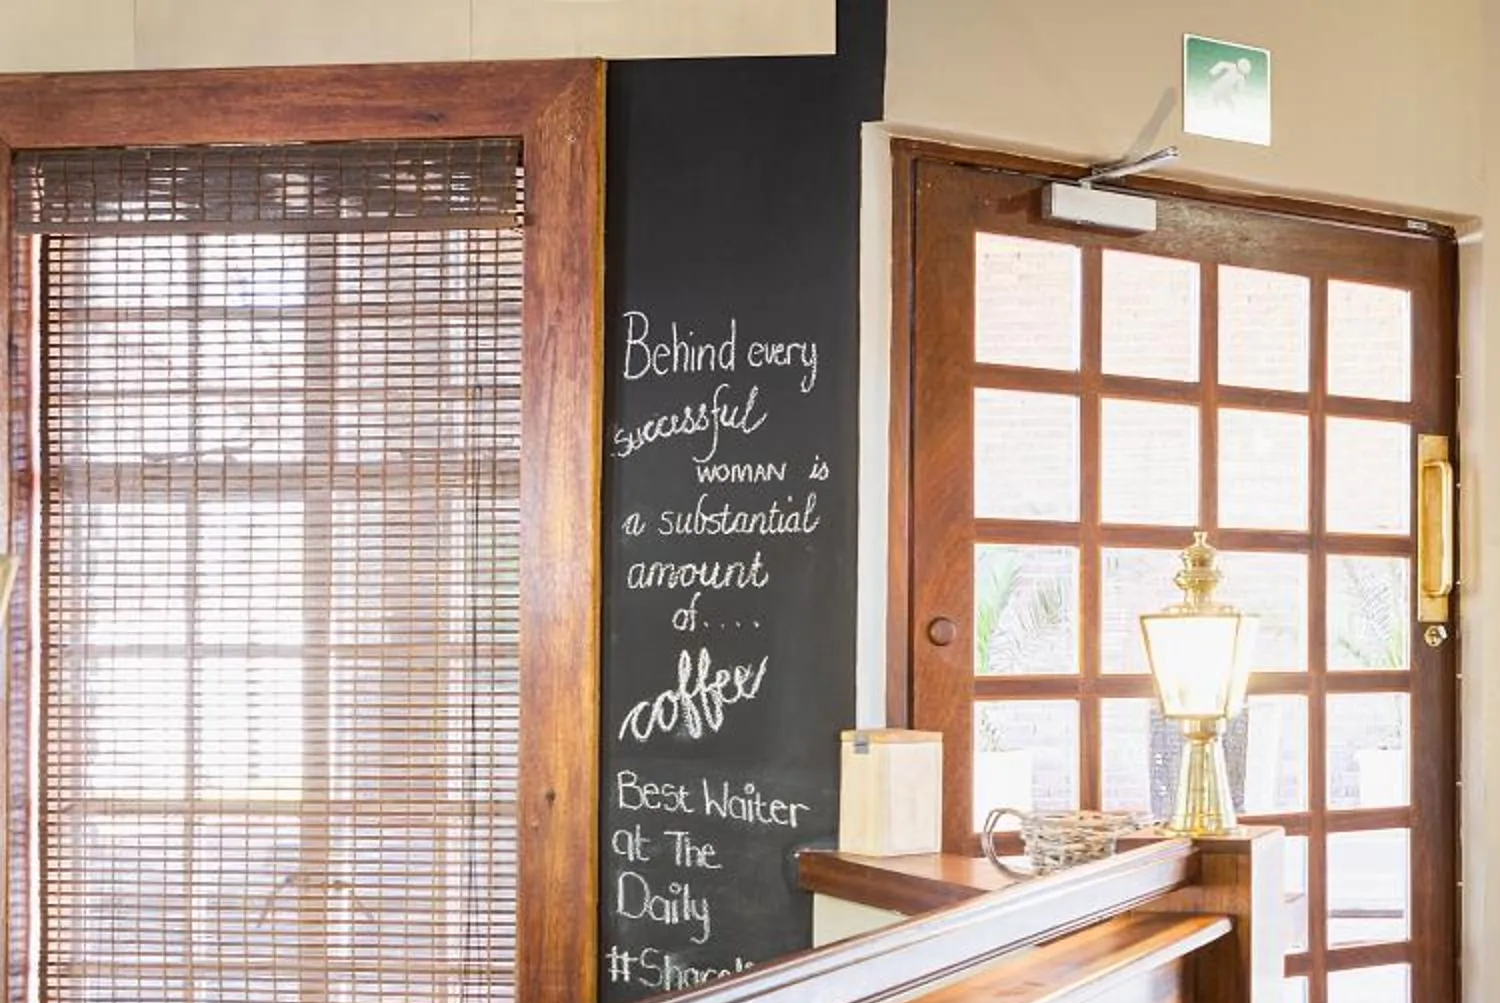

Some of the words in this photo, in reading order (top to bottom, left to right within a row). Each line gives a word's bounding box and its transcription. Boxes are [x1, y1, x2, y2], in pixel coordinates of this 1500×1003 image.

[623, 311, 736, 379] Behind
[747, 340, 818, 392] every
[610, 383, 767, 463] successful
[808, 454, 830, 481] is
[621, 511, 646, 536] a
[657, 492, 820, 535] substantial
[627, 550, 769, 589] amount
[618, 647, 769, 742] coffee
[616, 769, 695, 813] Best
[702, 777, 811, 828] Waiter
[611, 823, 650, 862] at
[663, 830, 723, 869] The
[616, 871, 711, 944] Daily
